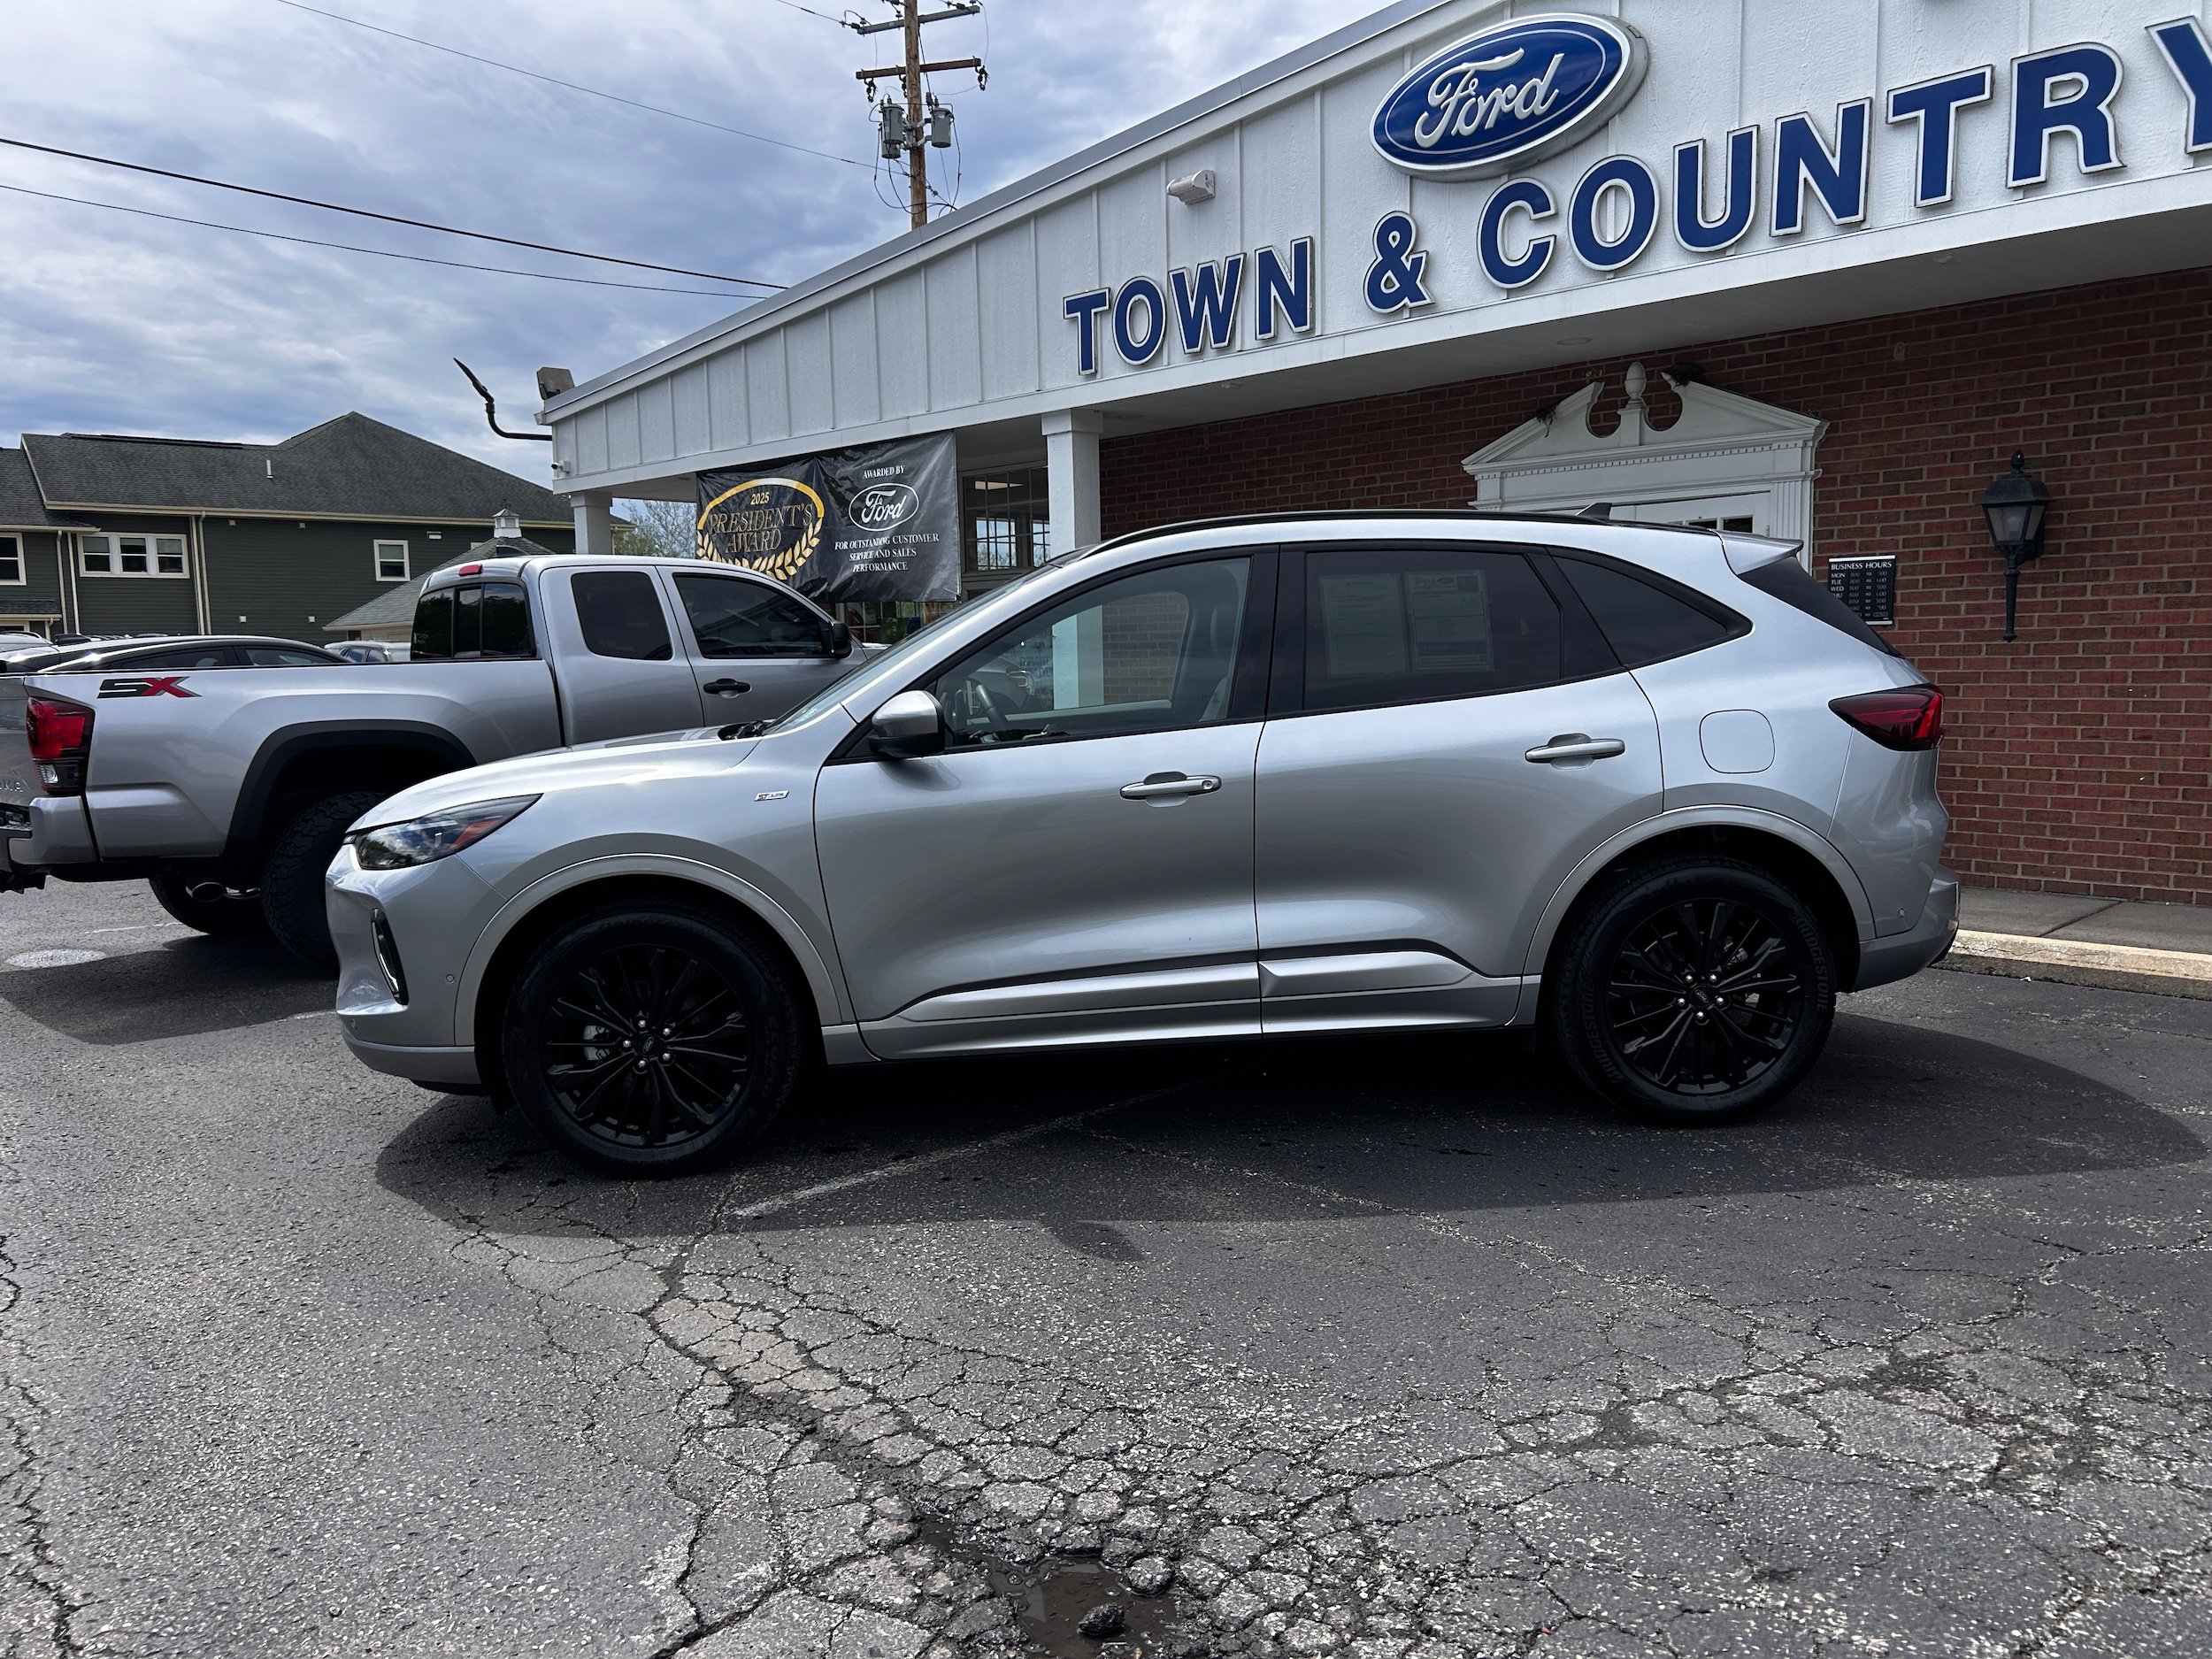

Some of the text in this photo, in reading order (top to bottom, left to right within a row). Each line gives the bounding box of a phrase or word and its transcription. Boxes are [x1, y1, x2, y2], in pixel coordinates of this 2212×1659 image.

[1416, 48, 1565, 148] Ford
[1063, 235, 1314, 376] TOWN
[1363, 210, 1435, 314] &
[863, 465, 905, 479] AWARDED BY
[750, 492, 770, 505] 2025
[861, 489, 907, 524] Ford
[709, 503, 813, 534] PRESIDENT'S
[725, 528, 782, 553] AWARD
[834, 541, 849, 550] FOR
[892, 533, 940, 544] CUSTOMER
[849, 547, 917, 562] SERVICE AND SALES
[853, 561, 909, 573] PERFORMANCE
[1831, 562, 1863, 571] BUSINESS
[1789, 911, 1830, 1013] BRIDGESTONE
[1581, 984, 1624, 1084] BRIDGESTONE
